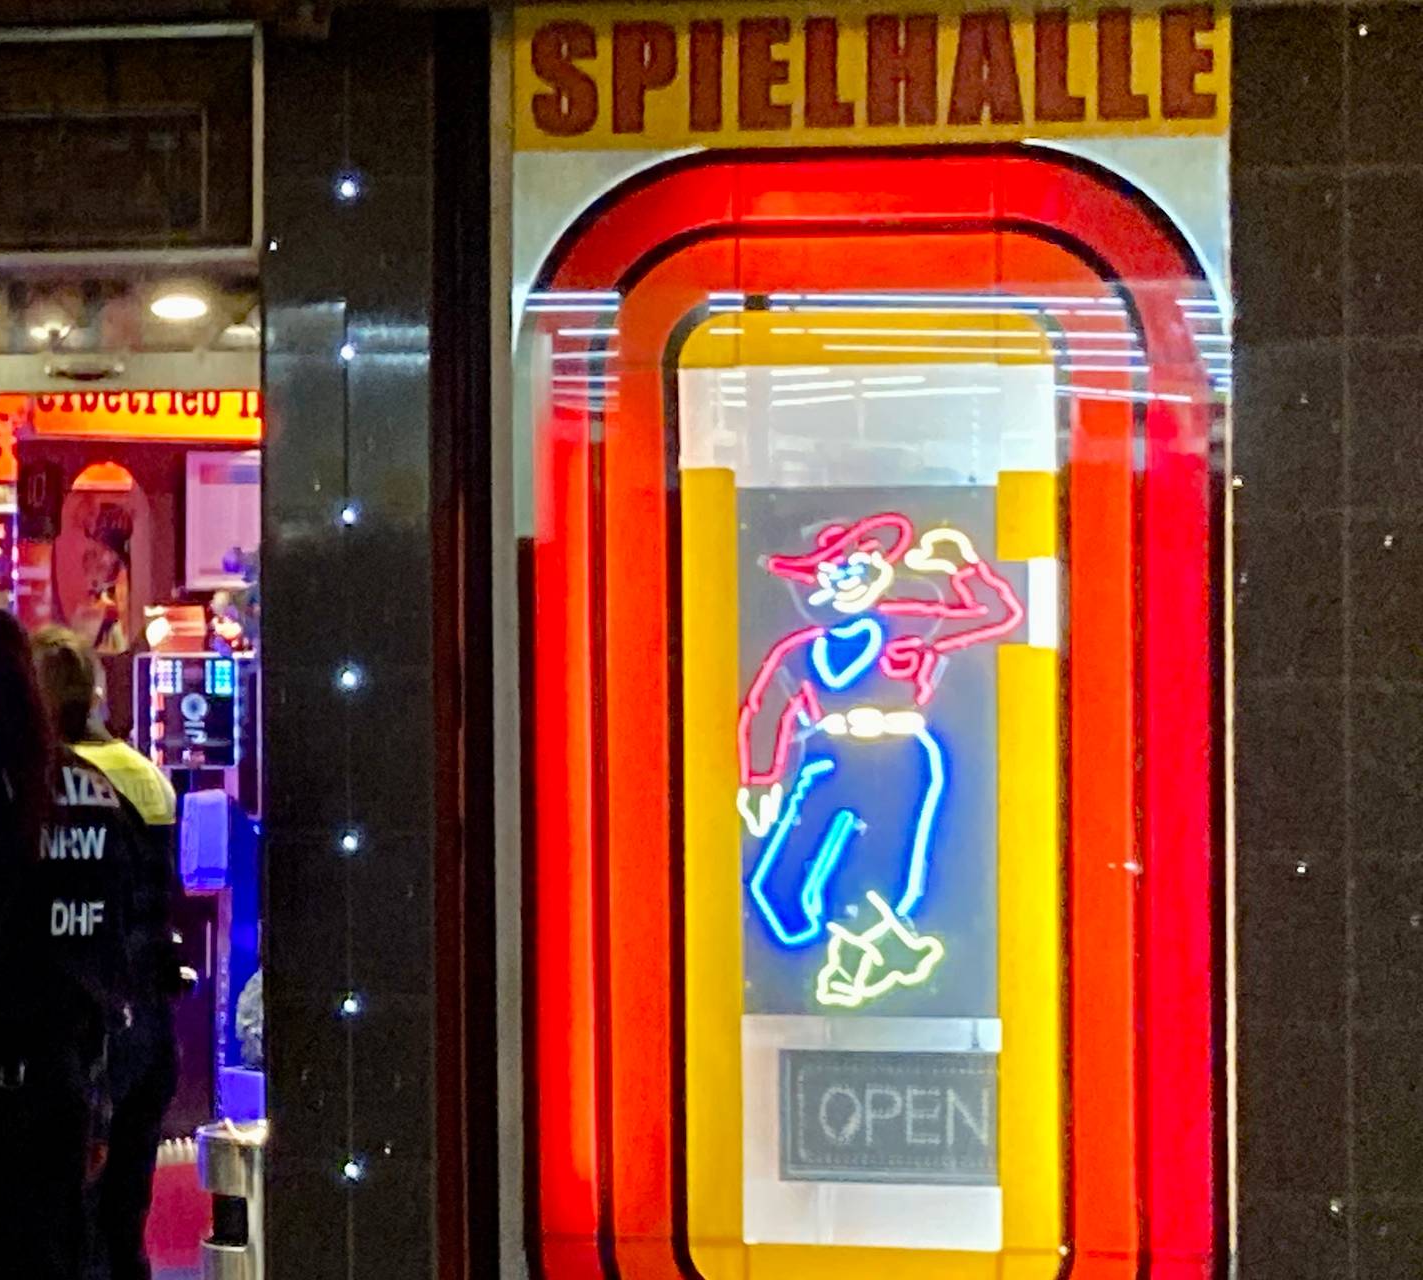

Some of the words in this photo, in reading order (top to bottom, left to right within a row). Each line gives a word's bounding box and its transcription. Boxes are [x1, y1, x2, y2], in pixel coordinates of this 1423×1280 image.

[530, 7, 1218, 135] SPIELHALLE
[39, 825, 108, 861] NRW
[50, 901, 105, 937] DHF
[819, 1083, 991, 1147] OPEN
